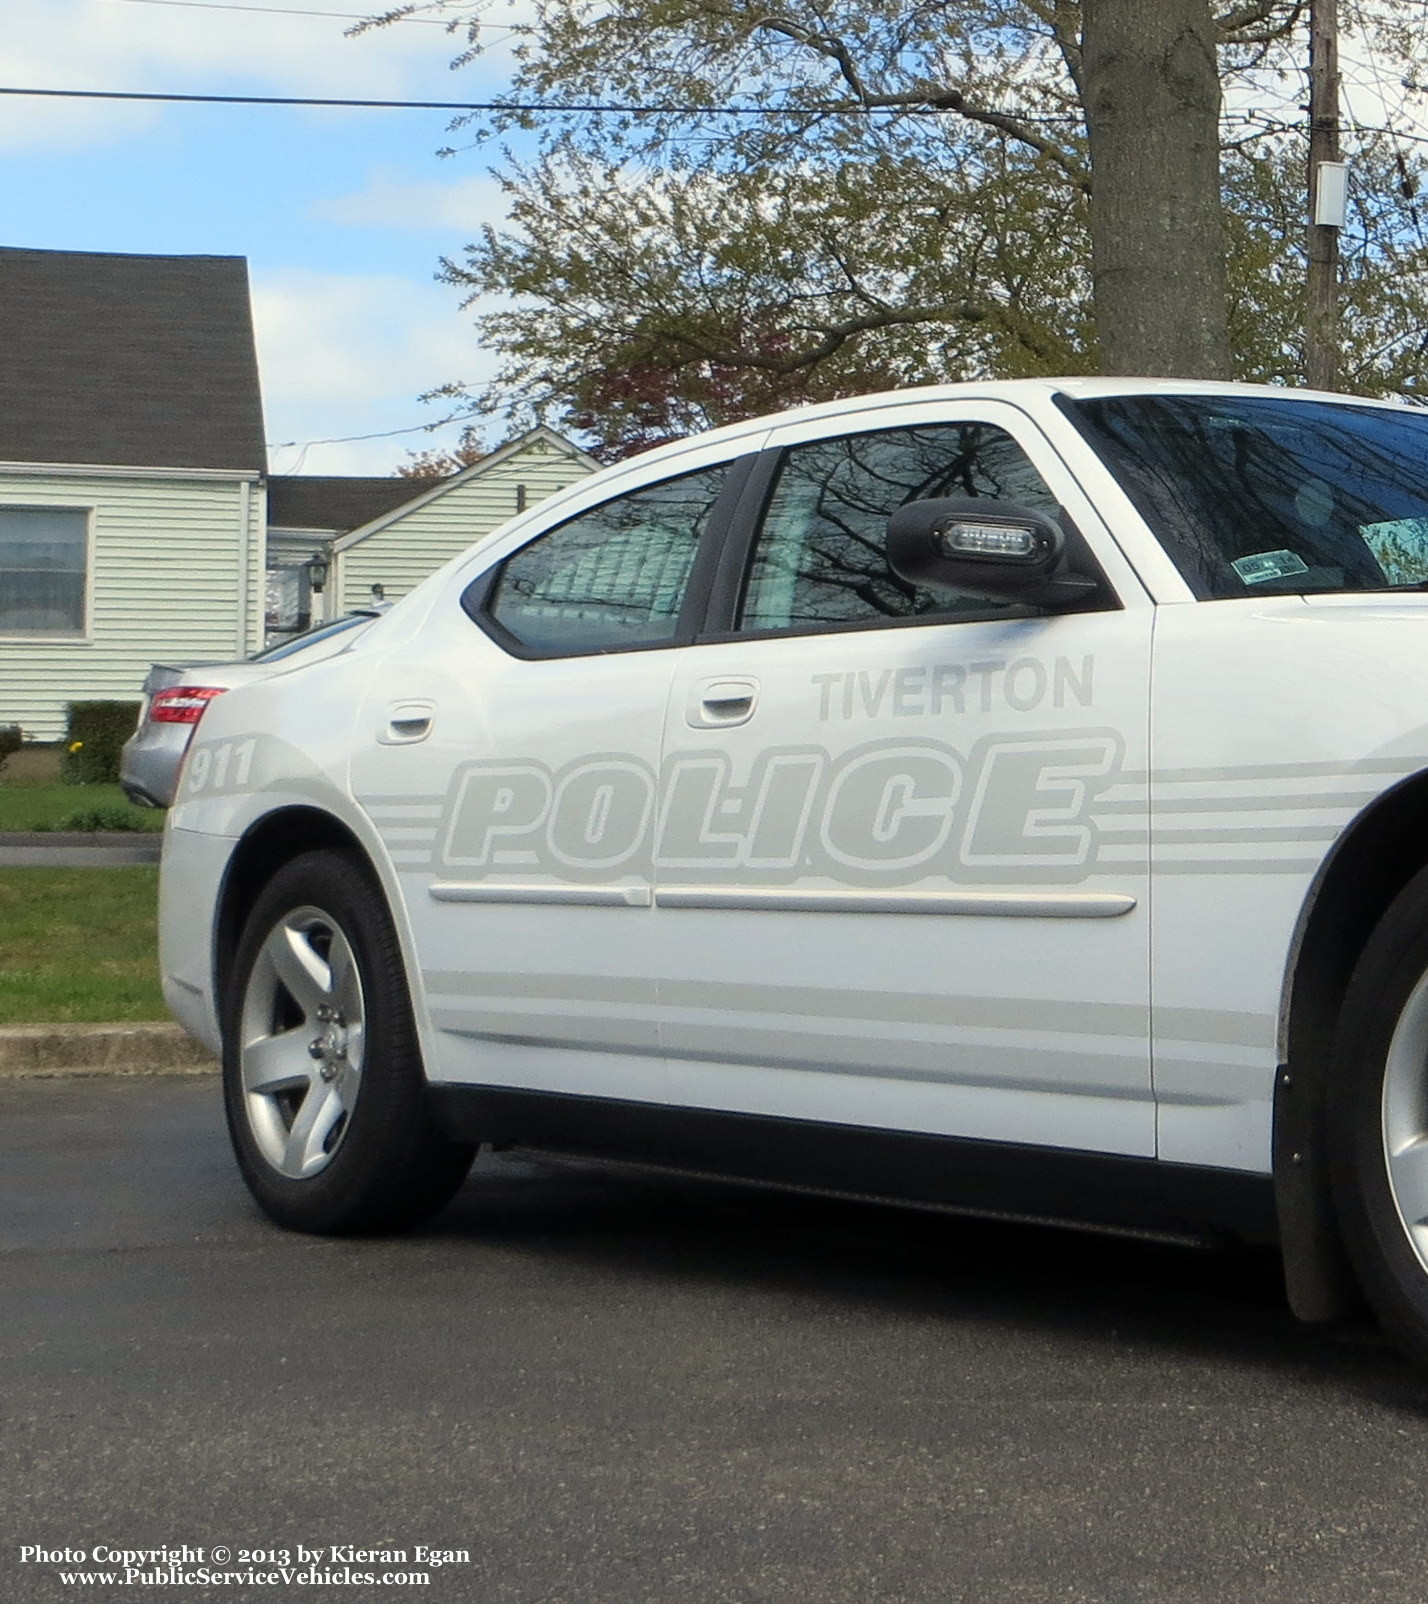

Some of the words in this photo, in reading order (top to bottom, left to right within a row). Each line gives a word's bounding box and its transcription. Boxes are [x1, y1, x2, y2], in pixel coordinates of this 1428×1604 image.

[811, 655, 1095, 722] TIVERTON
[189, 739, 257, 793] 911
[439, 737, 1115, 870] POLICE
